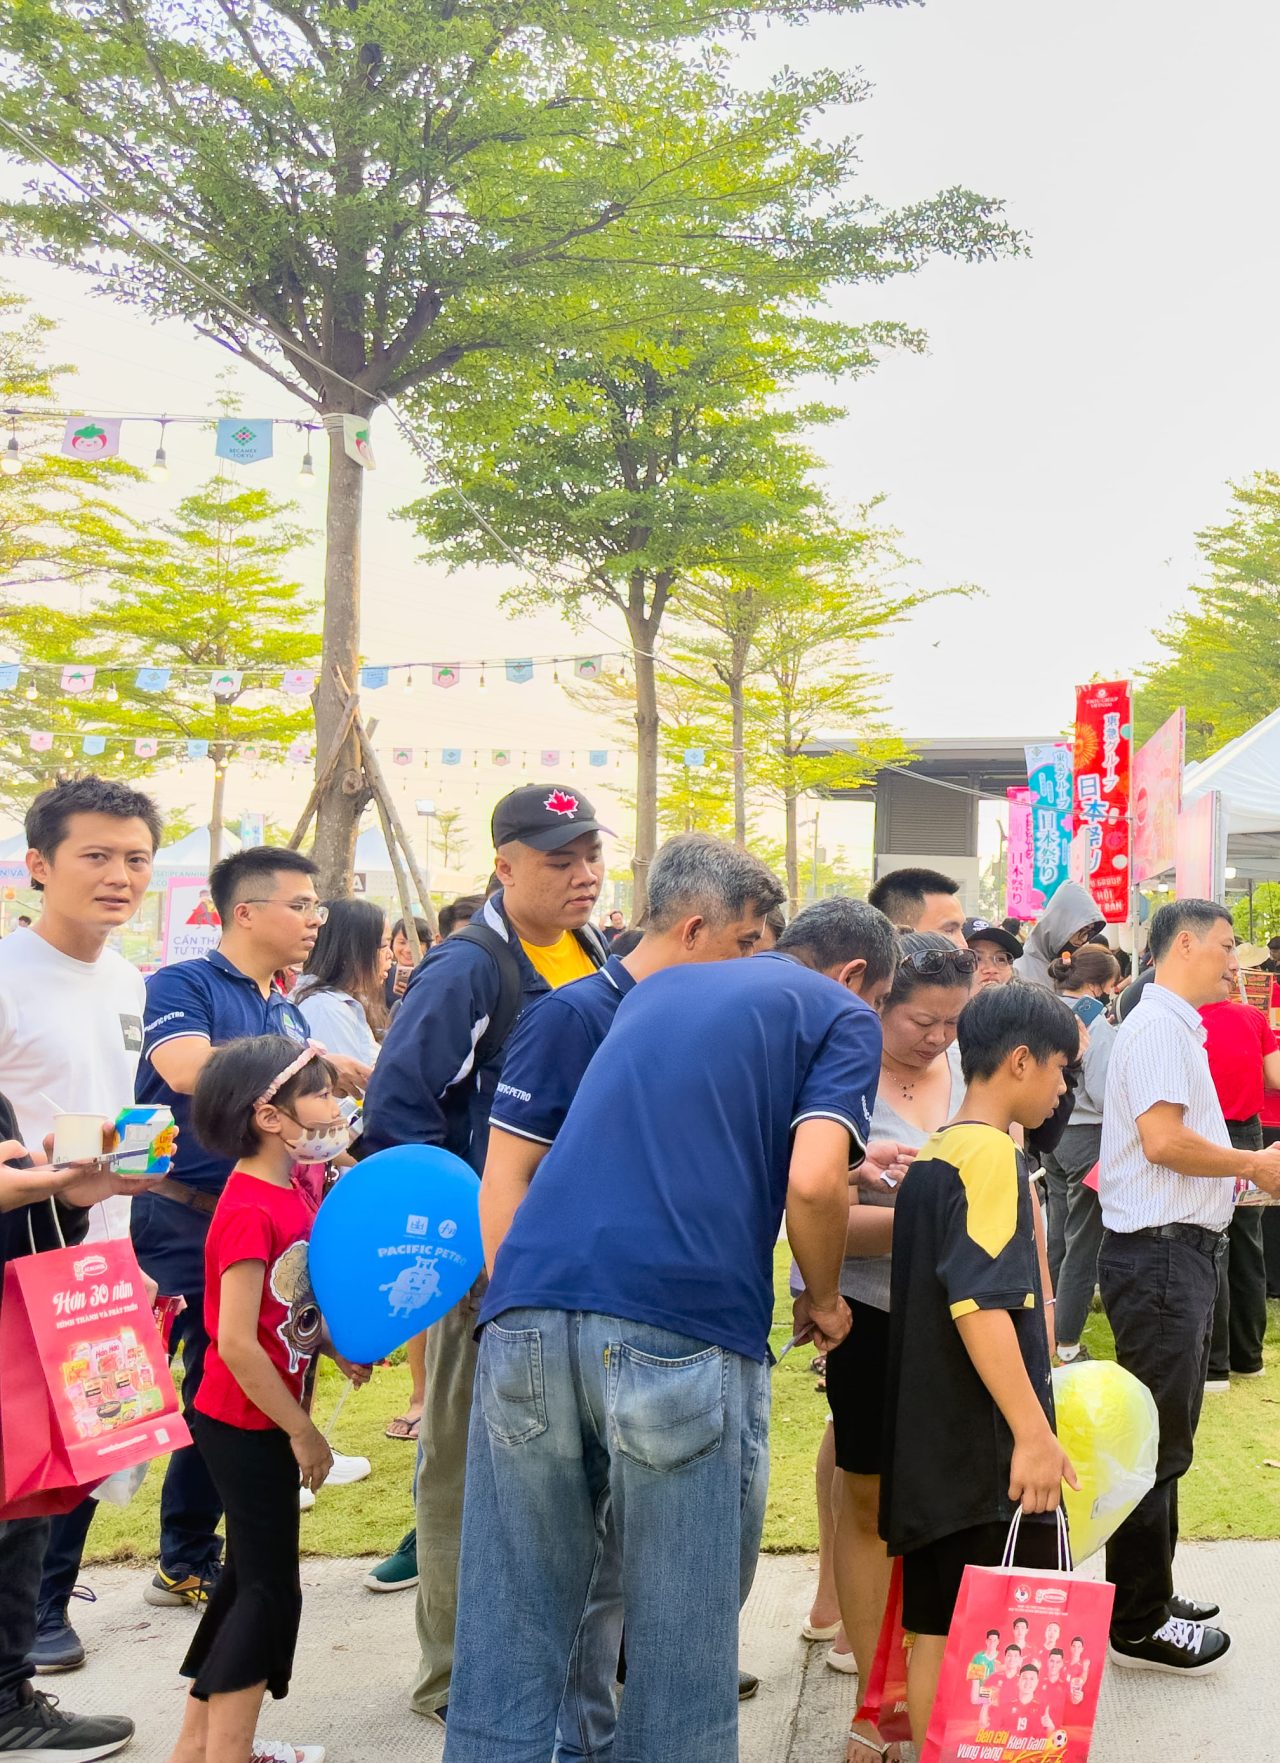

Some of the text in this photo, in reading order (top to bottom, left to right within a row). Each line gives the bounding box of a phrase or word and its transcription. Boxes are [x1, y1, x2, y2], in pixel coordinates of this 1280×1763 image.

[509, 1087, 531, 1102] PETRO
[378, 1244, 467, 1266] PACIFIC PETRO
[53, 1280, 133, 1316] Hơn 30 năm
[1017, 1717, 1027, 1731] 19
